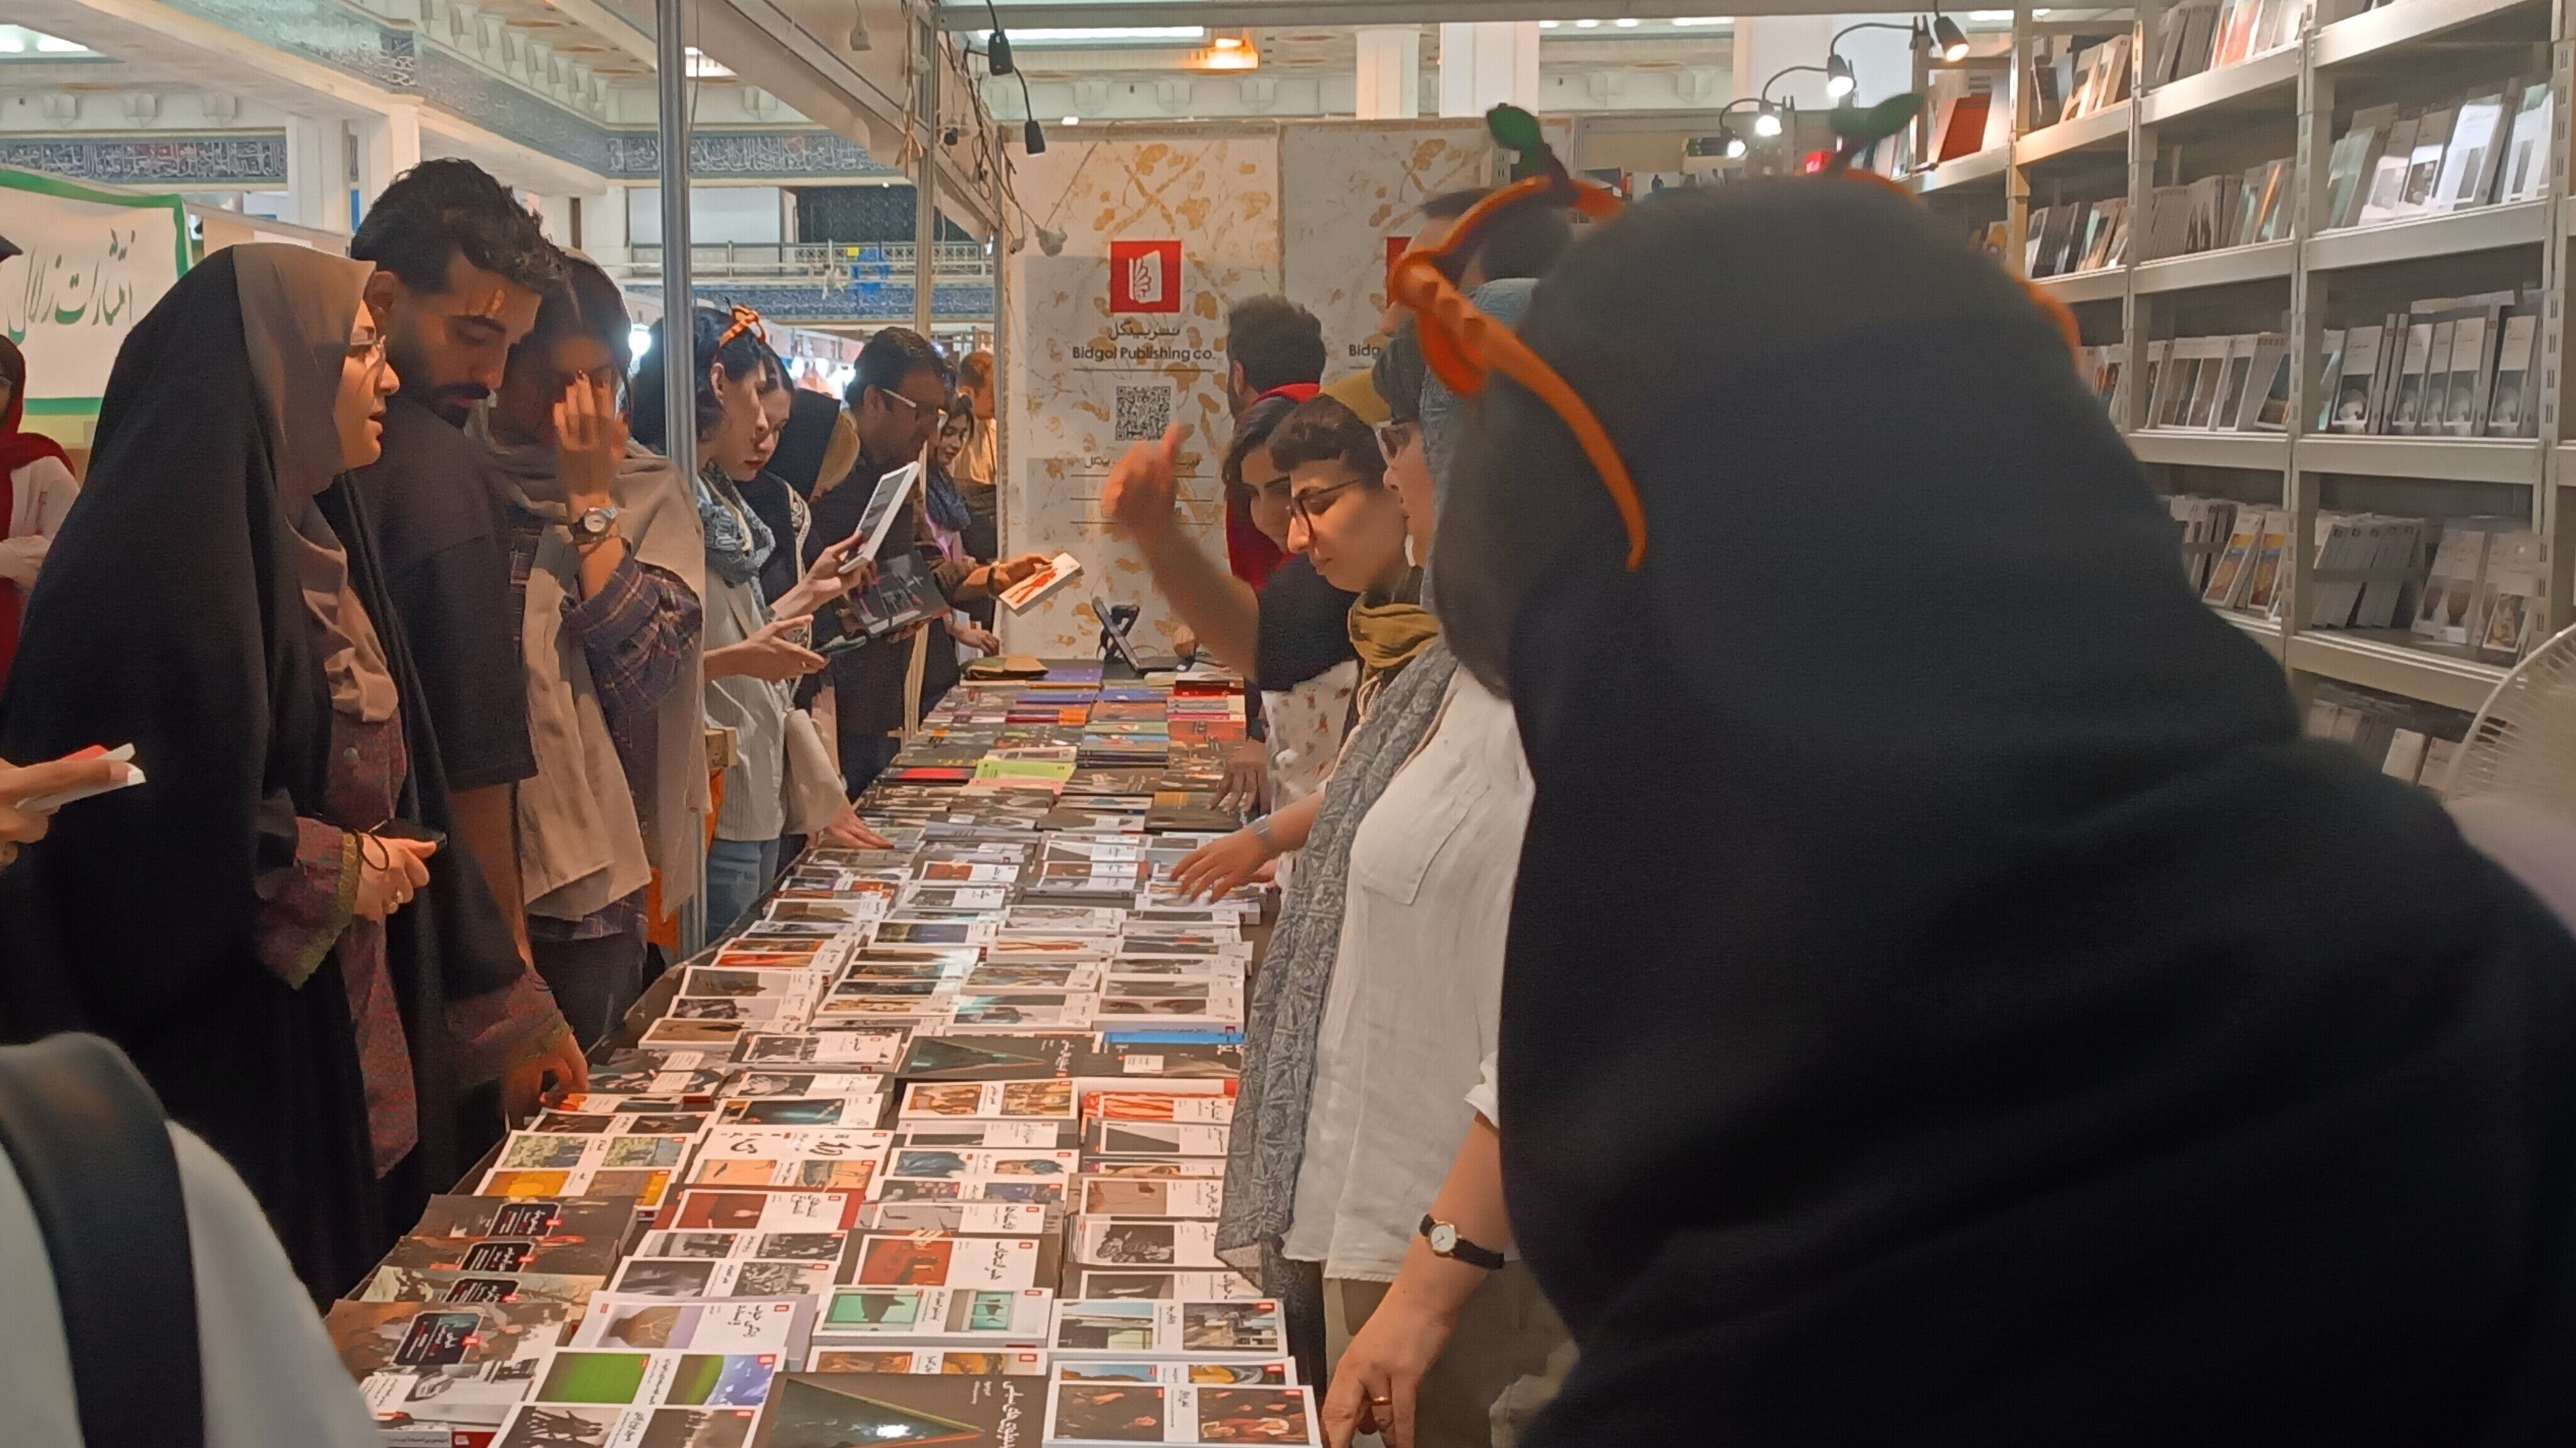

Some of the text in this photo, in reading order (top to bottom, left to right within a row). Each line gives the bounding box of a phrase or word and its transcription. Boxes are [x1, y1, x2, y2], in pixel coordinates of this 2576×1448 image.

[7, 228, 135, 345] انتشارات زلال
[1072, 346, 1216, 362] Bidgol Publishing co.
[1348, 343, 1380, 360] Bidg
